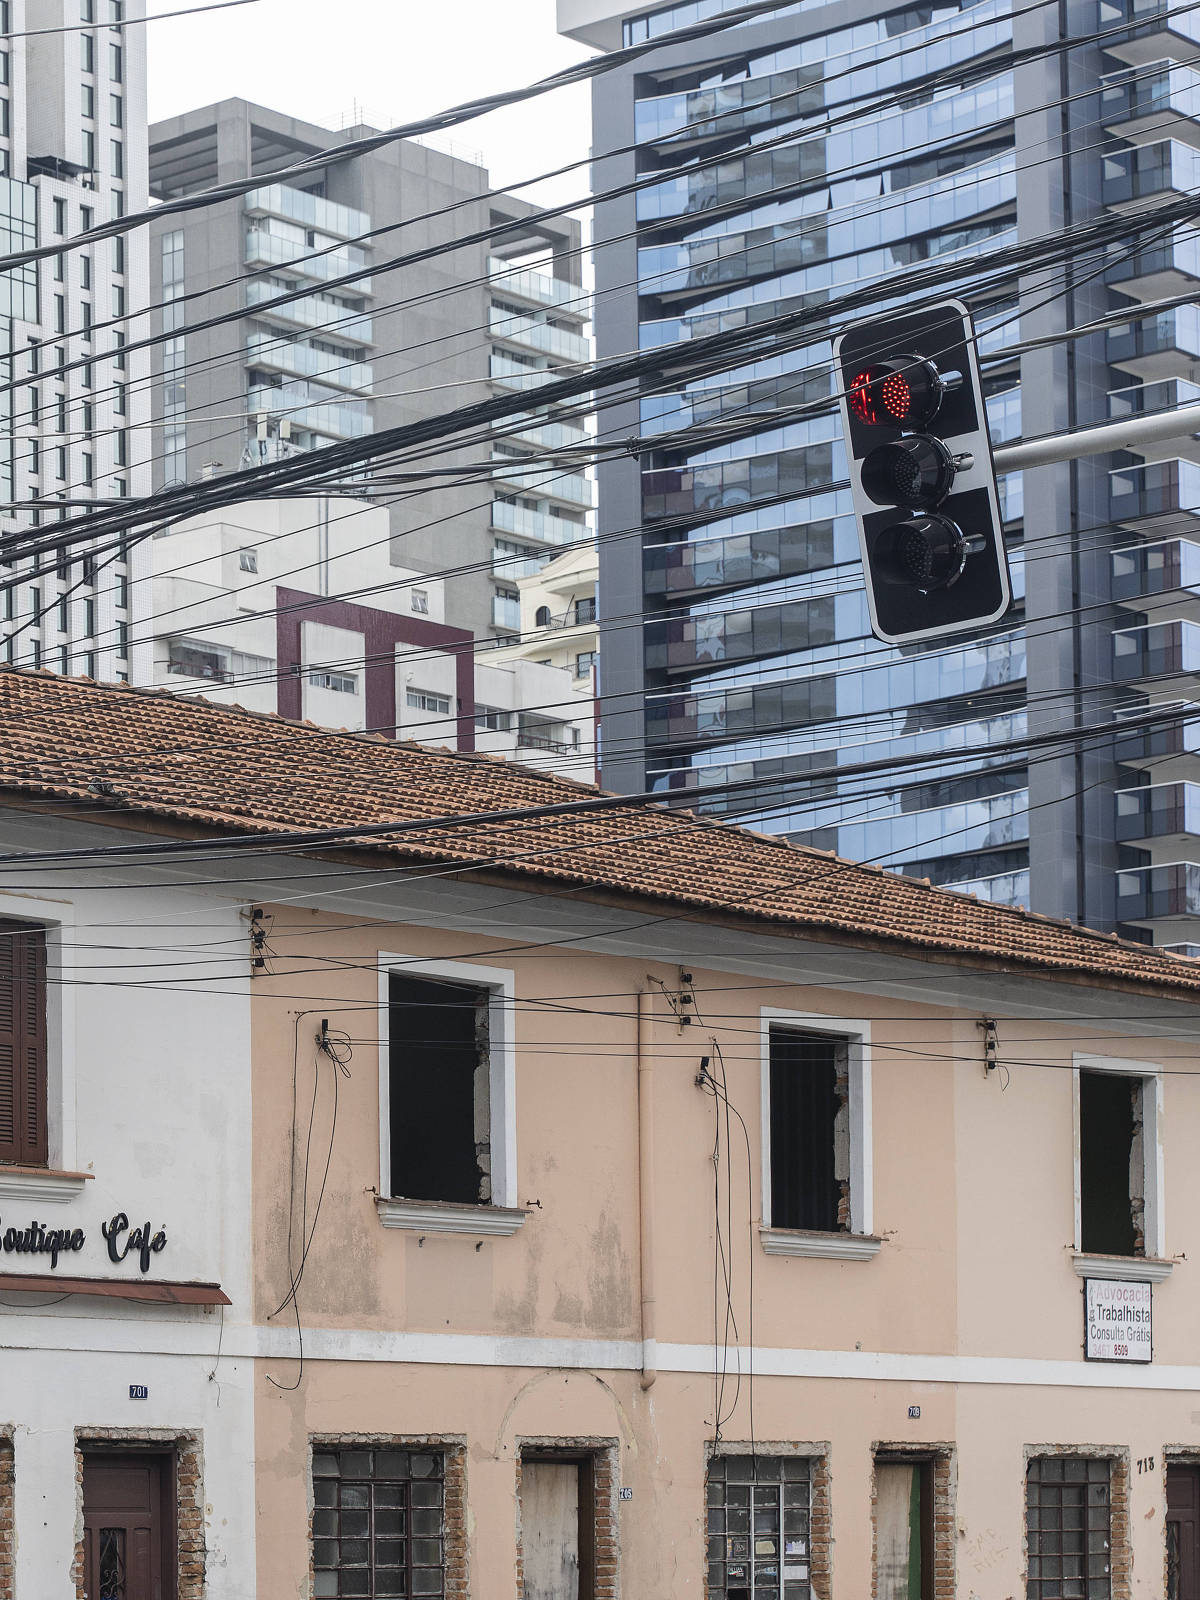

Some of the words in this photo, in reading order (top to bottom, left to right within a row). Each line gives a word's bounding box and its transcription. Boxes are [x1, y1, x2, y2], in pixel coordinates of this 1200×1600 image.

[101, 1212, 168, 1273] Café
[1096, 1303, 1151, 1323] Trabalhista
[1090, 1324, 1125, 1341] Consulta
[1126, 1325, 1151, 1343] Grátis
[1113, 1343, 1129, 1356] 8509
[132, 1386, 145, 1397] 701
[1137, 1456, 1155, 1475] 713
